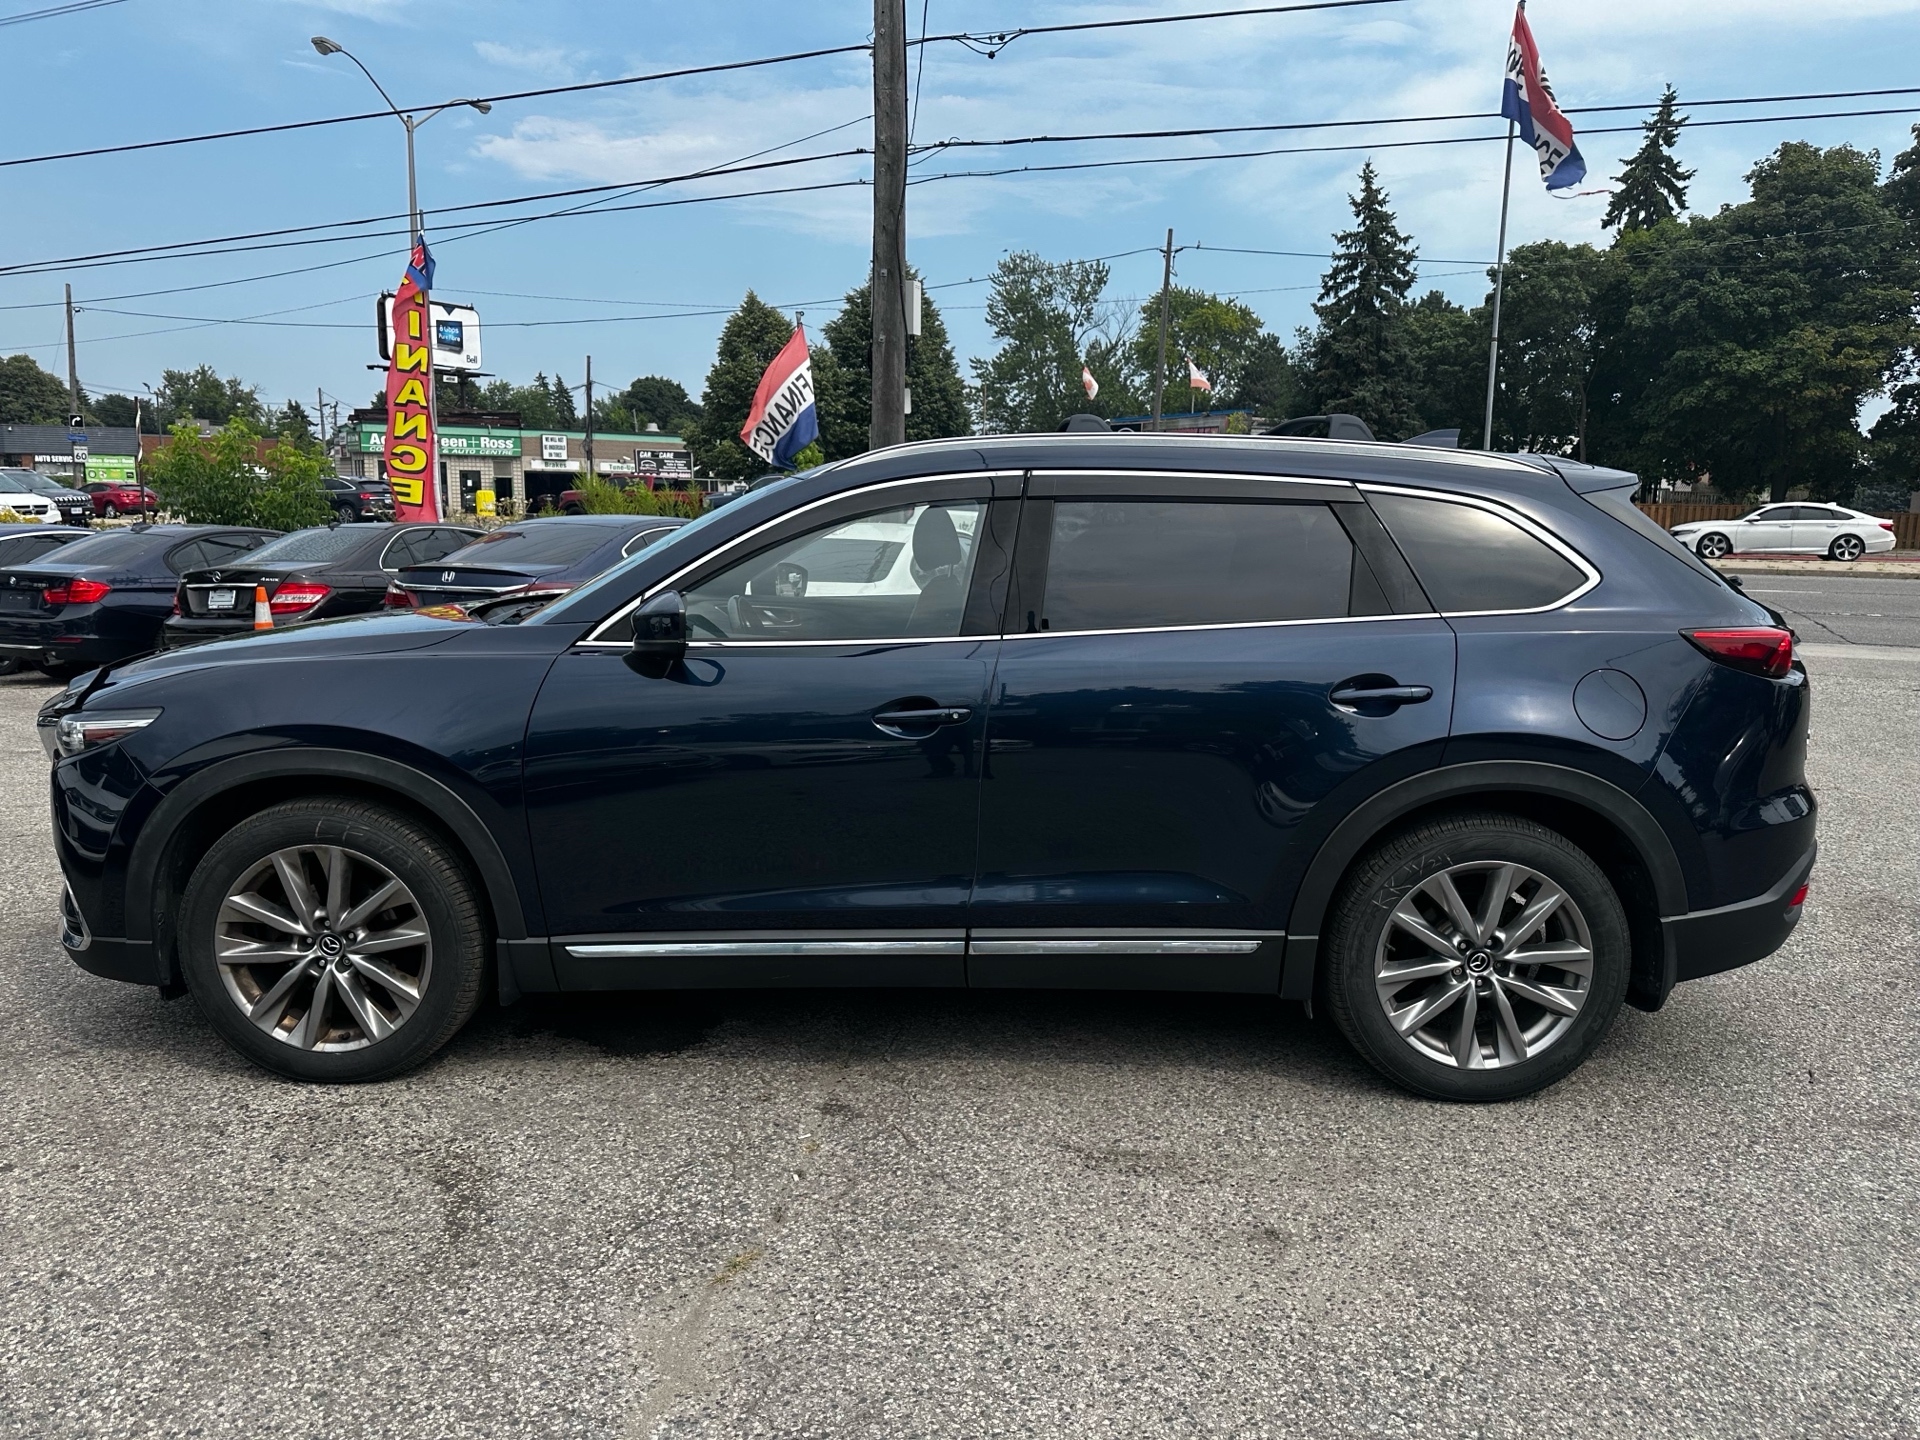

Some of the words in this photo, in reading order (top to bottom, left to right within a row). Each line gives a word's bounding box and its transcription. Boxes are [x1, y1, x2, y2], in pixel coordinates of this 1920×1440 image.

[466, 354, 478, 364] Bell
[51, 455, 73, 463] SERVIC
[75, 452, 87, 460] 60
[544, 461, 567, 469] Brakes
